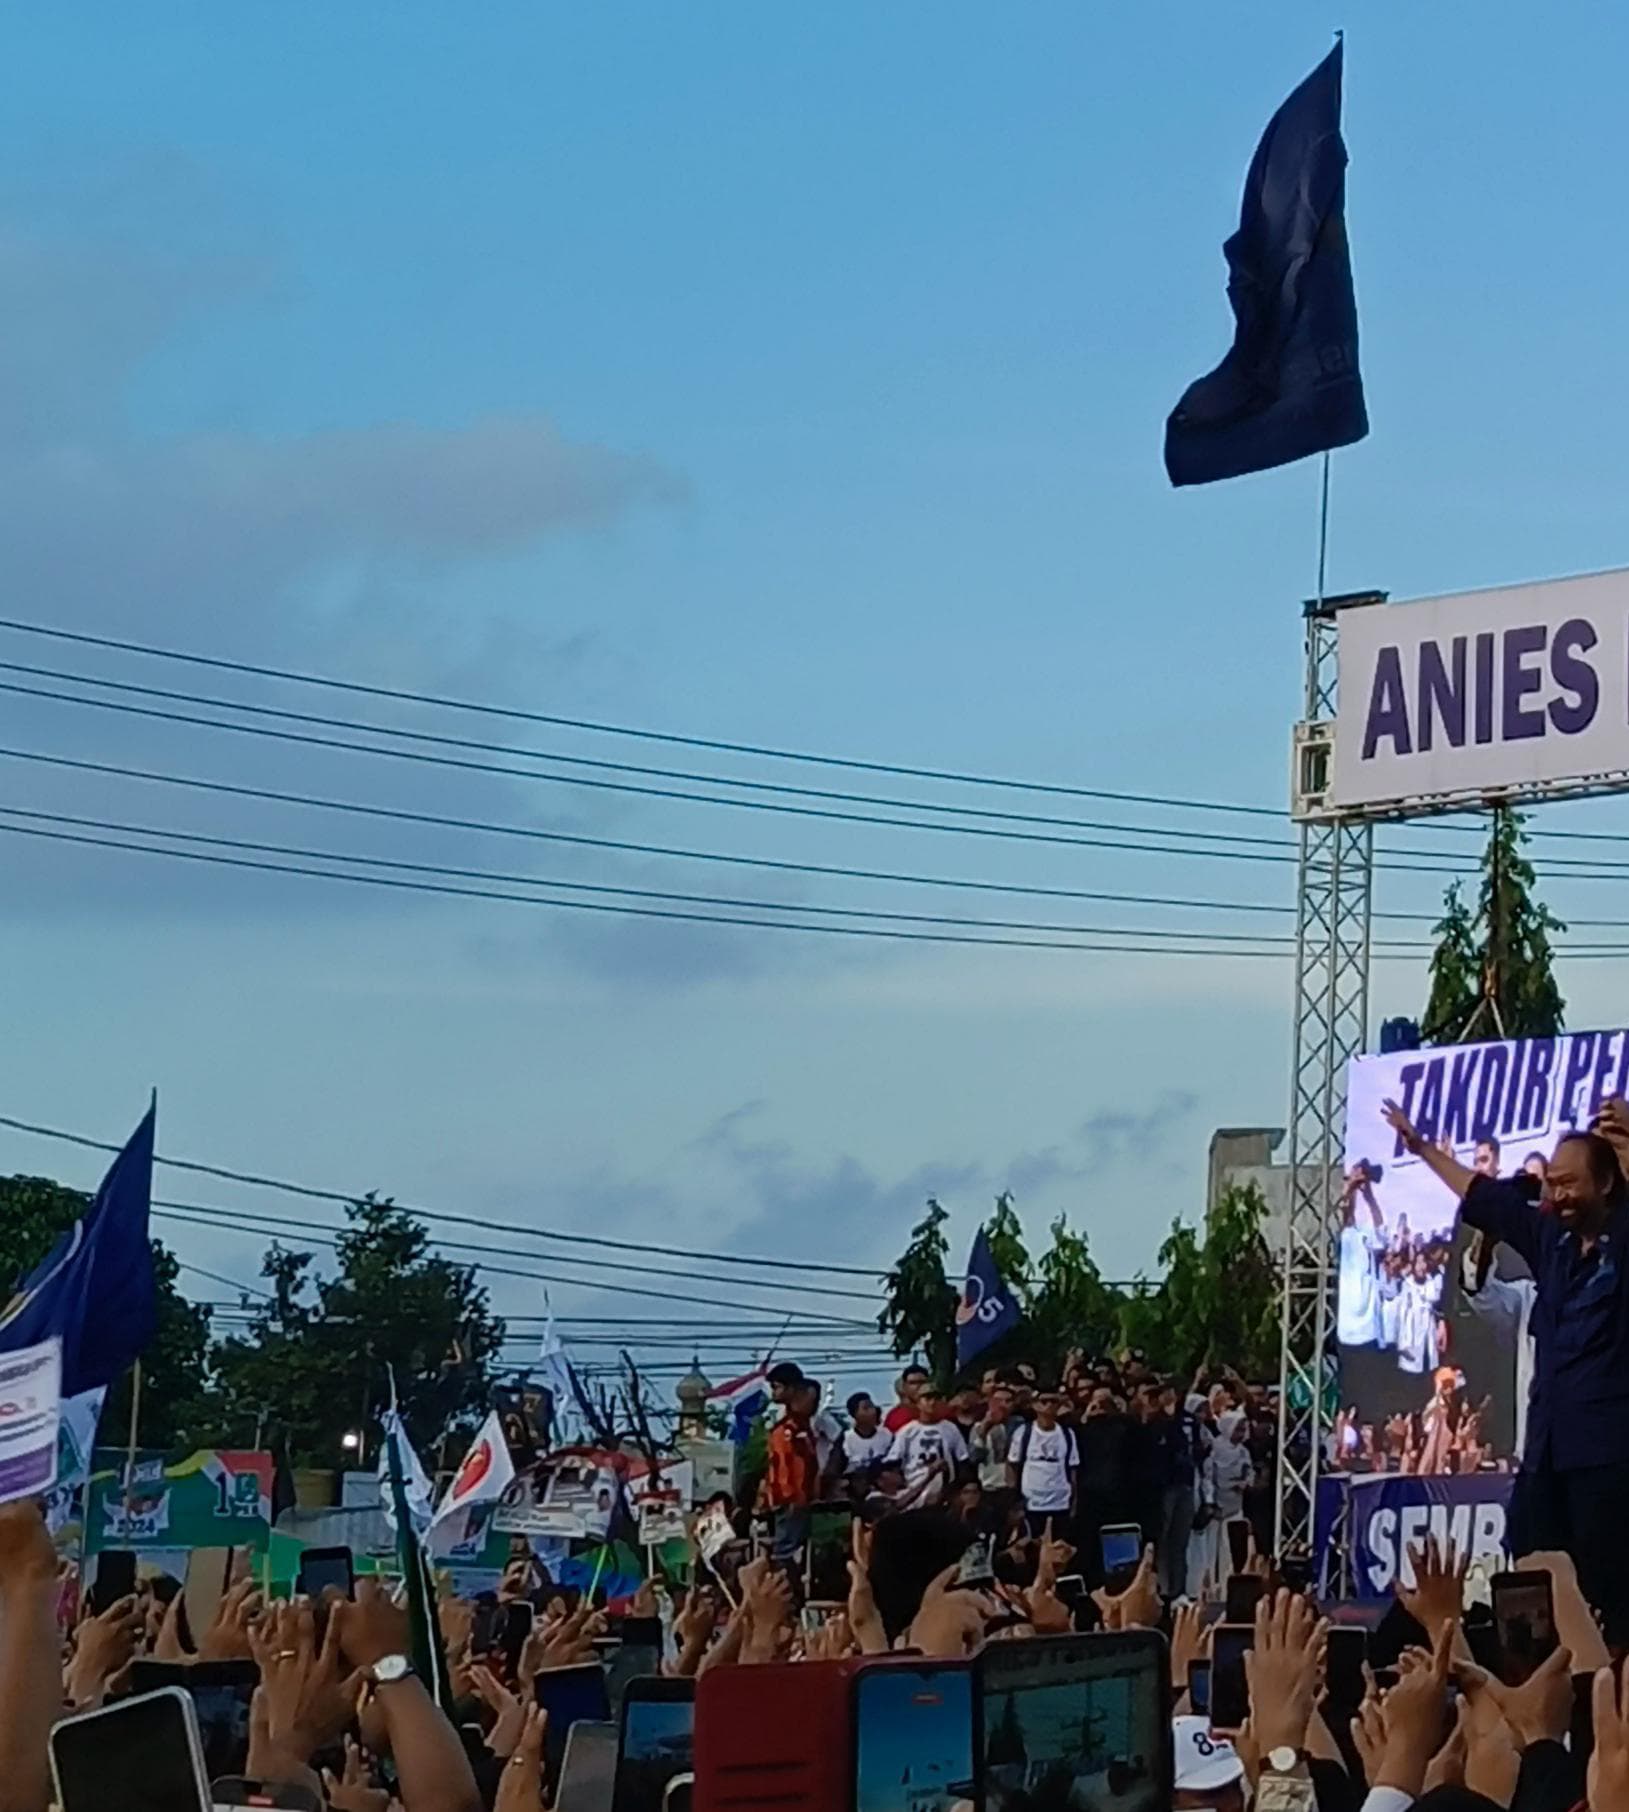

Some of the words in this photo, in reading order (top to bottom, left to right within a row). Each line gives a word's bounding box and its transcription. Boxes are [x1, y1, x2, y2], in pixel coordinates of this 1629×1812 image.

[1361, 617, 1600, 760] ANIES
[1393, 1039, 1556, 1158] TAKDIR
[1192, 1731, 1229, 1757] 8
